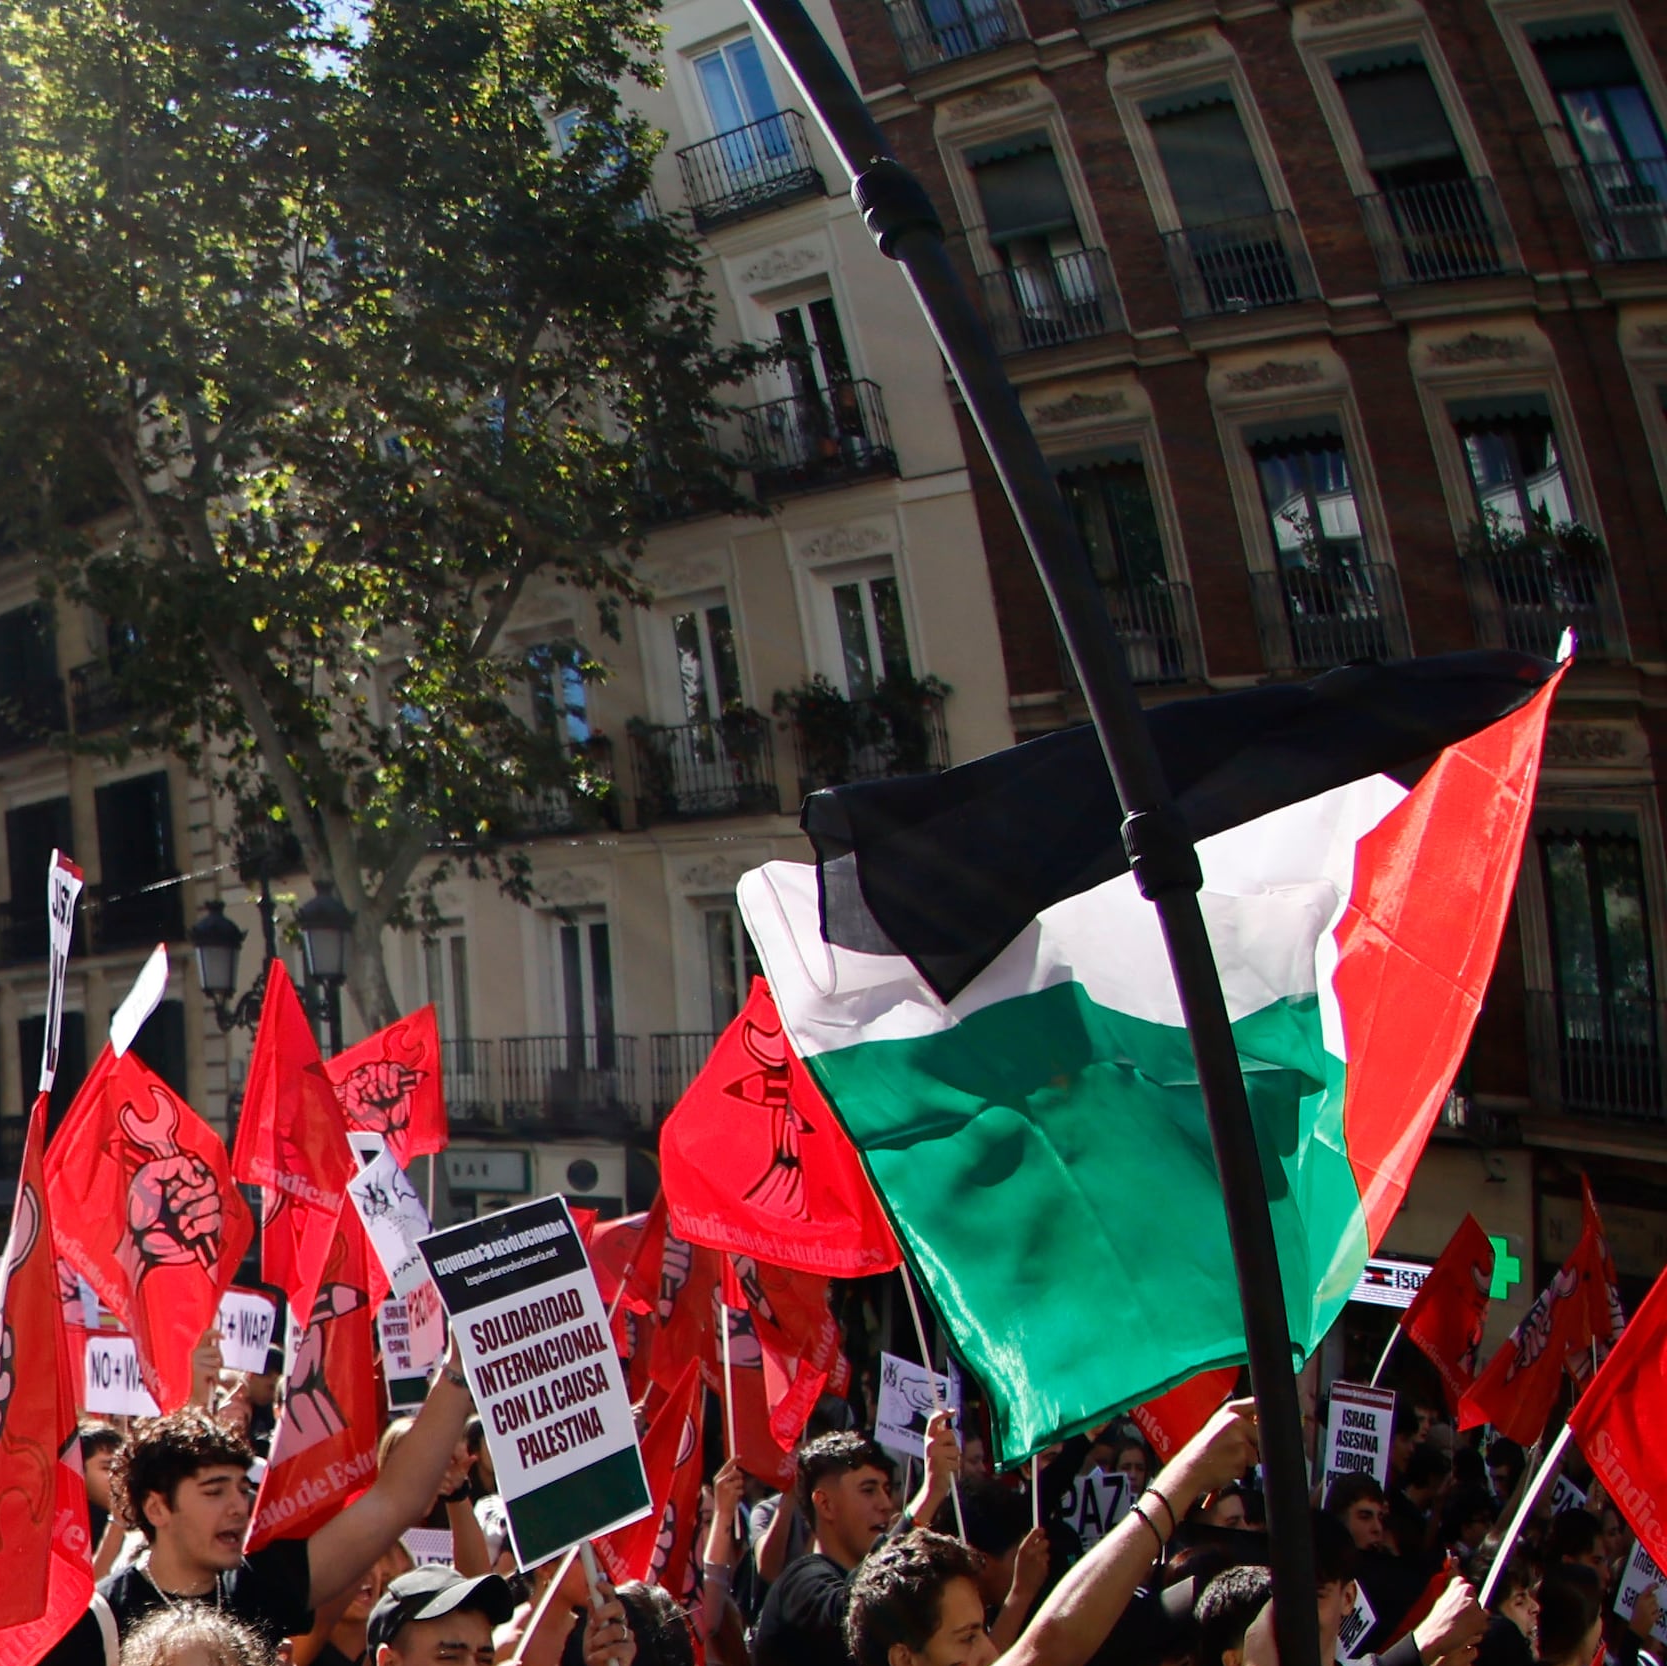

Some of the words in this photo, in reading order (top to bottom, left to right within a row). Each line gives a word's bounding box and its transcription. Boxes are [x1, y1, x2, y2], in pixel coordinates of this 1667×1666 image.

[434, 1245, 484, 1278] IZQUIERDA
[491, 1217, 570, 1259] REVOLUCIONARIA
[470, 1287, 585, 1356] SOLIDARIDAD
[92, 1359, 111, 1389] NO
[475, 1321, 608, 1399] INTERNACIONAL
[491, 1396, 532, 1437] CON
[530, 1387, 554, 1423] LA
[552, 1362, 611, 1412] CAUSA
[1341, 1408, 1377, 1432] ISRAEL
[516, 1406, 606, 1471] PALESTINA
[1334, 1451, 1375, 1477] EUROPA
[1336, 1430, 1379, 1455] ASESINA
